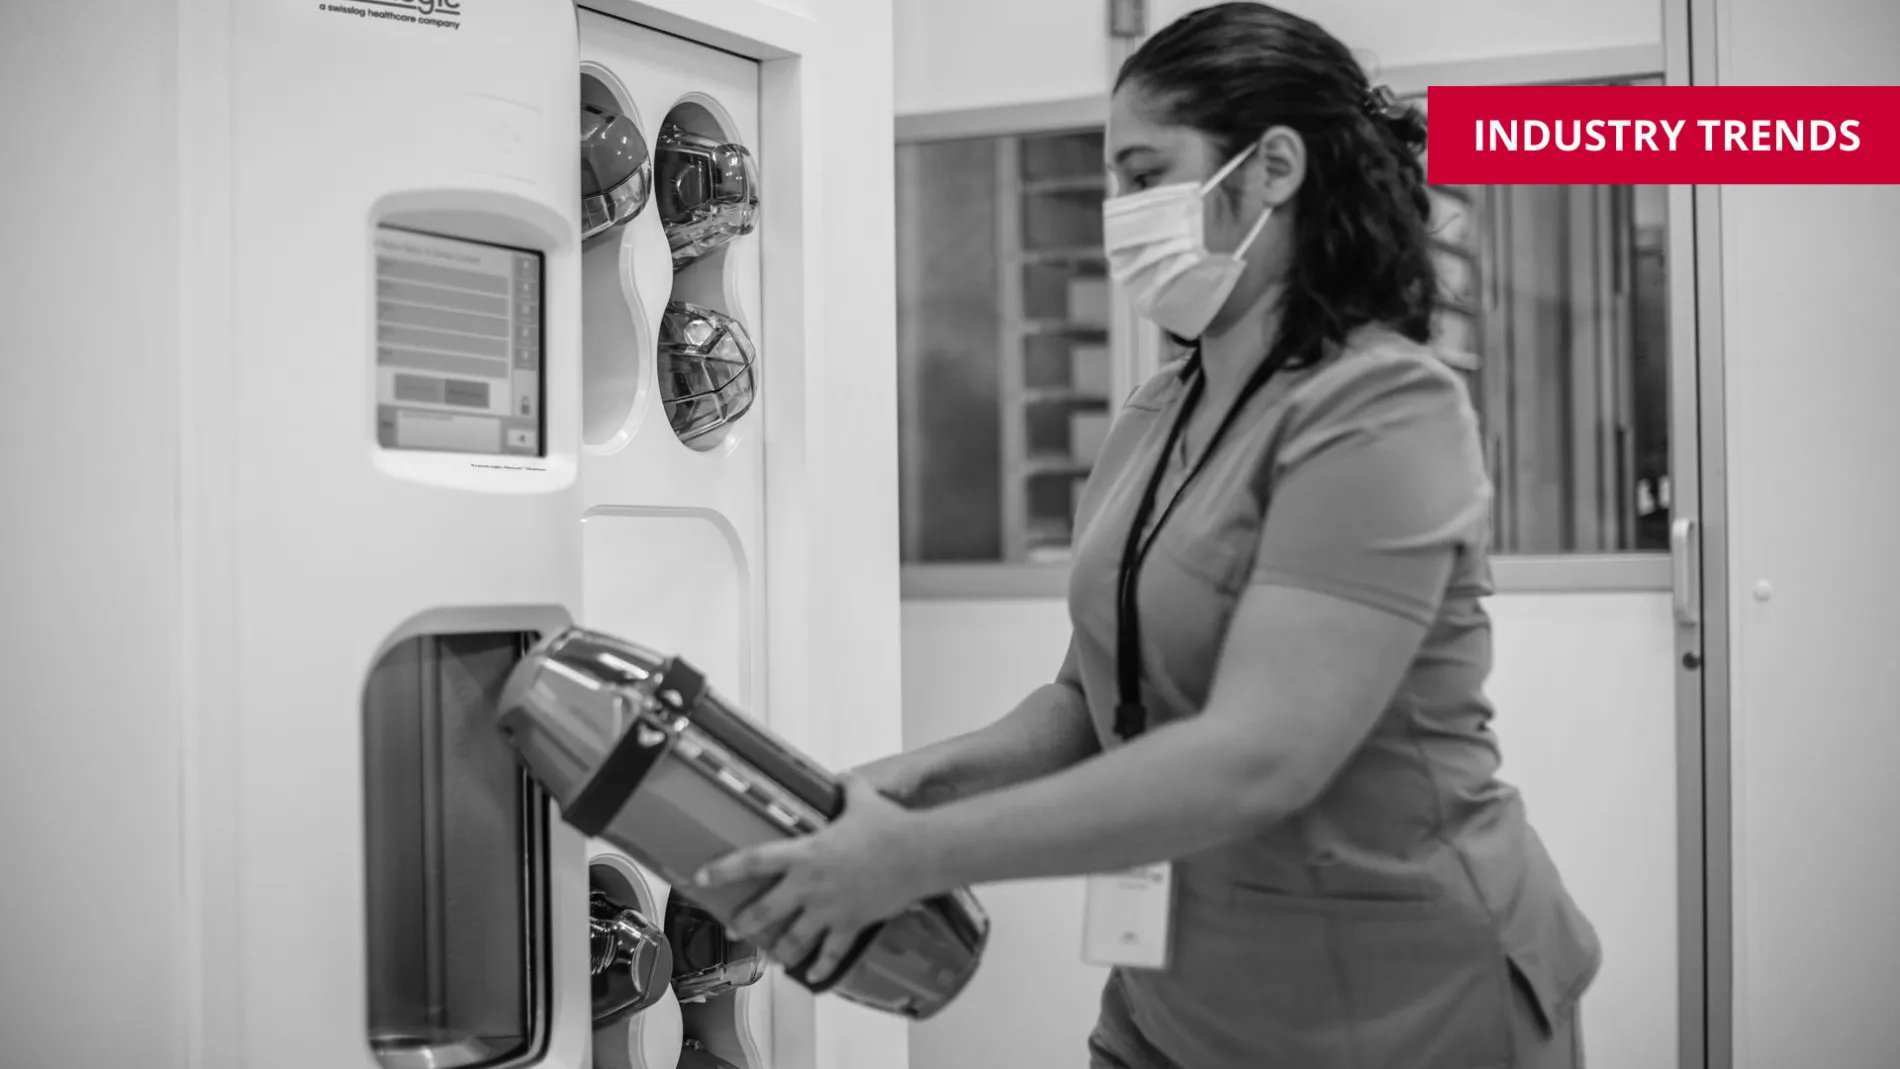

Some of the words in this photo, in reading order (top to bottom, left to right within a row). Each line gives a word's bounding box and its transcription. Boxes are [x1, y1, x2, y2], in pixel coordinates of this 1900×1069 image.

[328, 4, 366, 17] swisslog
[367, 8, 417, 23] healthcare
[417, 17, 461, 30] company
